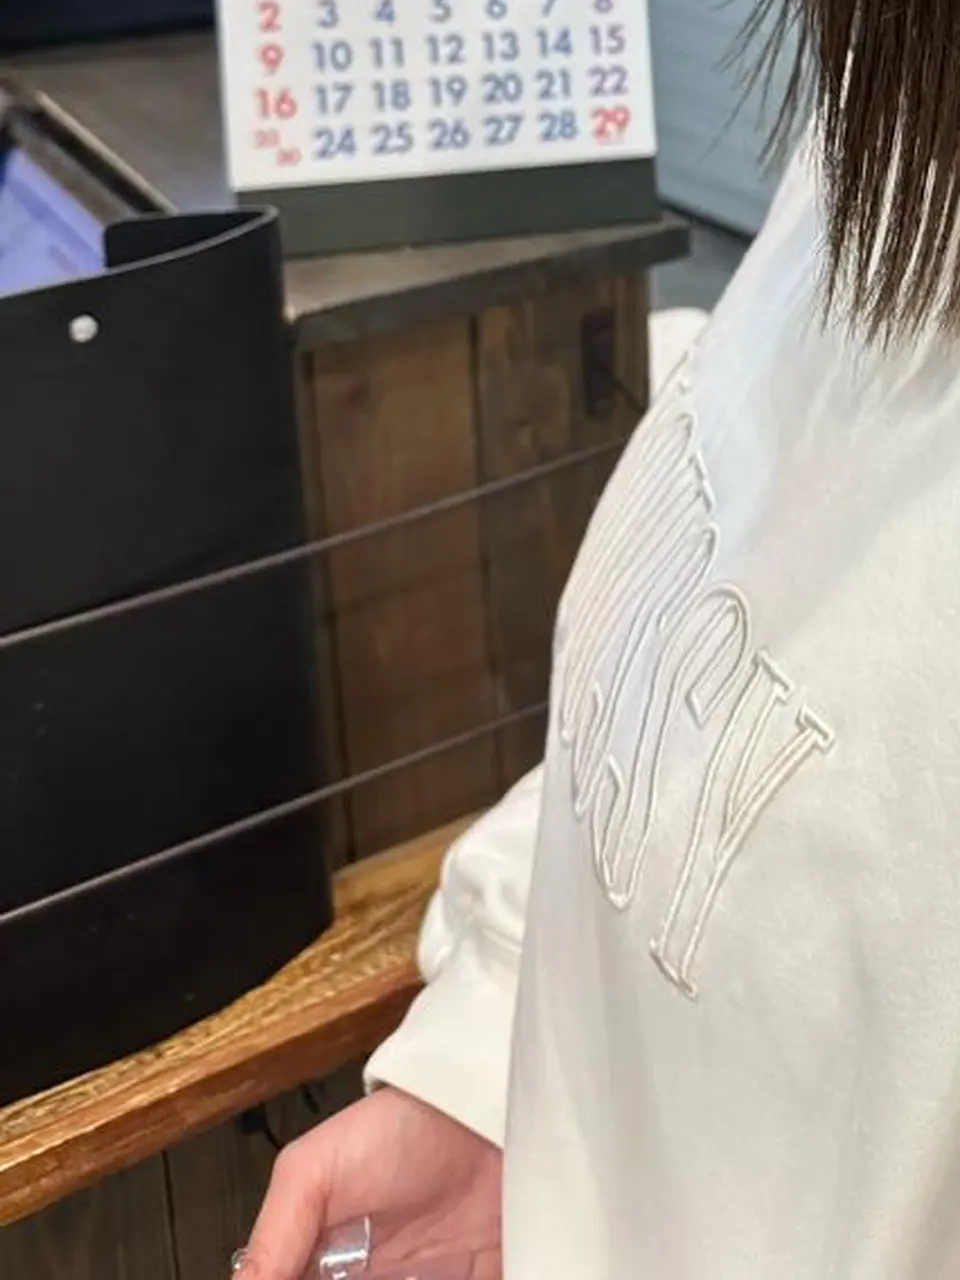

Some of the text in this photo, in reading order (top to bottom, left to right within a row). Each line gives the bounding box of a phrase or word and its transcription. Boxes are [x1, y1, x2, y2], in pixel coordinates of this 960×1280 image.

[257, 0, 281, 33] 2
[260, 25, 626, 76] 9 10 11 12 13 14 15
[257, 66, 629, 120] 16 17 18 19 20 21 22
[315, 124, 357, 160] 24
[371, 122, 414, 156] 25
[428, 117, 470, 150] 26
[484, 113, 525, 146] 27
[538, 110, 578, 142] 28
[592, 106, 631, 141] 29
